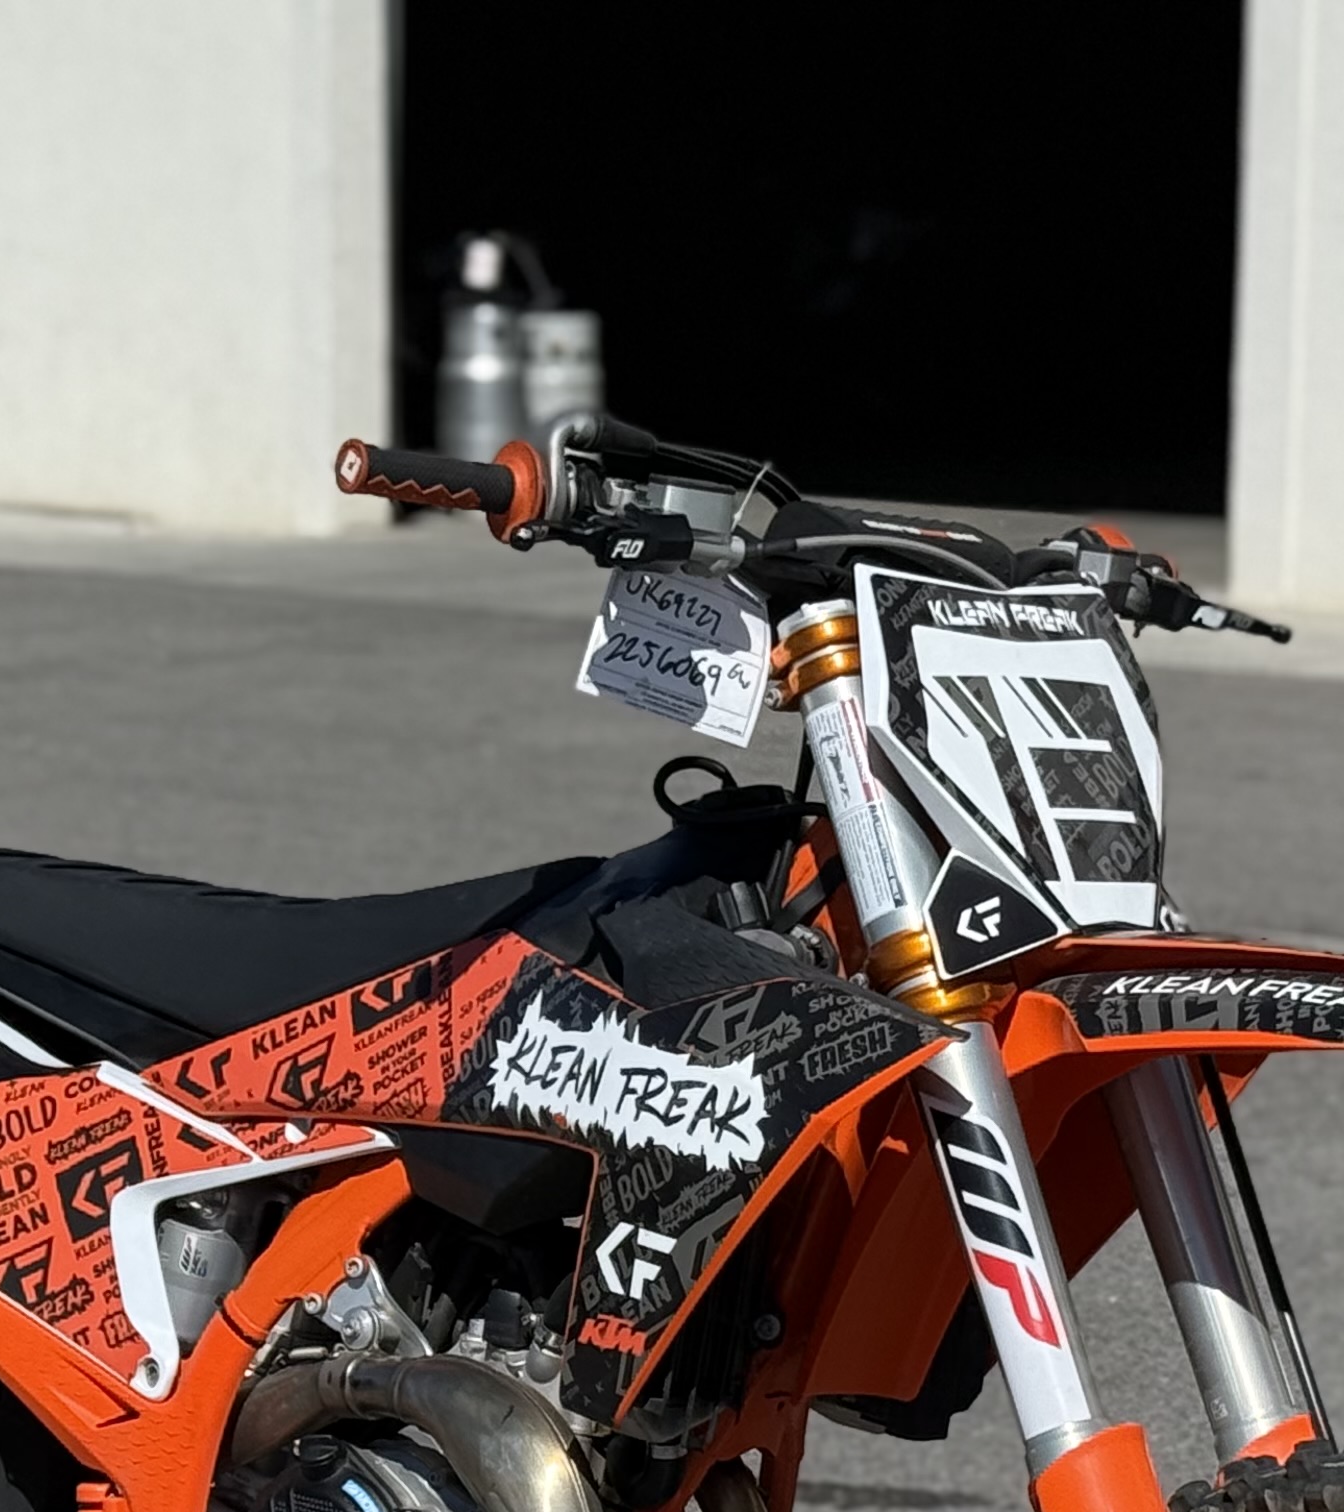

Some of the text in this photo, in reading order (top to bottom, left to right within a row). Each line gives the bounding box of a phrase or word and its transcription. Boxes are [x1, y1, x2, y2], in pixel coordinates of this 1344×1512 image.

[611, 539, 645, 559] FLO
[927, 599, 1011, 628] KLEAN
[1008, 602, 1085, 636] FREAK
[1106, 975, 1257, 997] KLEAN
[250, 1000, 338, 1060] KLEAN
[367, 1025, 428, 1070] SHOWER
[807, 1024, 889, 1077] FRESH
[373, 1051, 428, 1095] POCKET
[505, 1026, 614, 1107] KLEAN
[615, 1066, 752, 1147] FREAK
[577, 1313, 650, 1358] KTM
